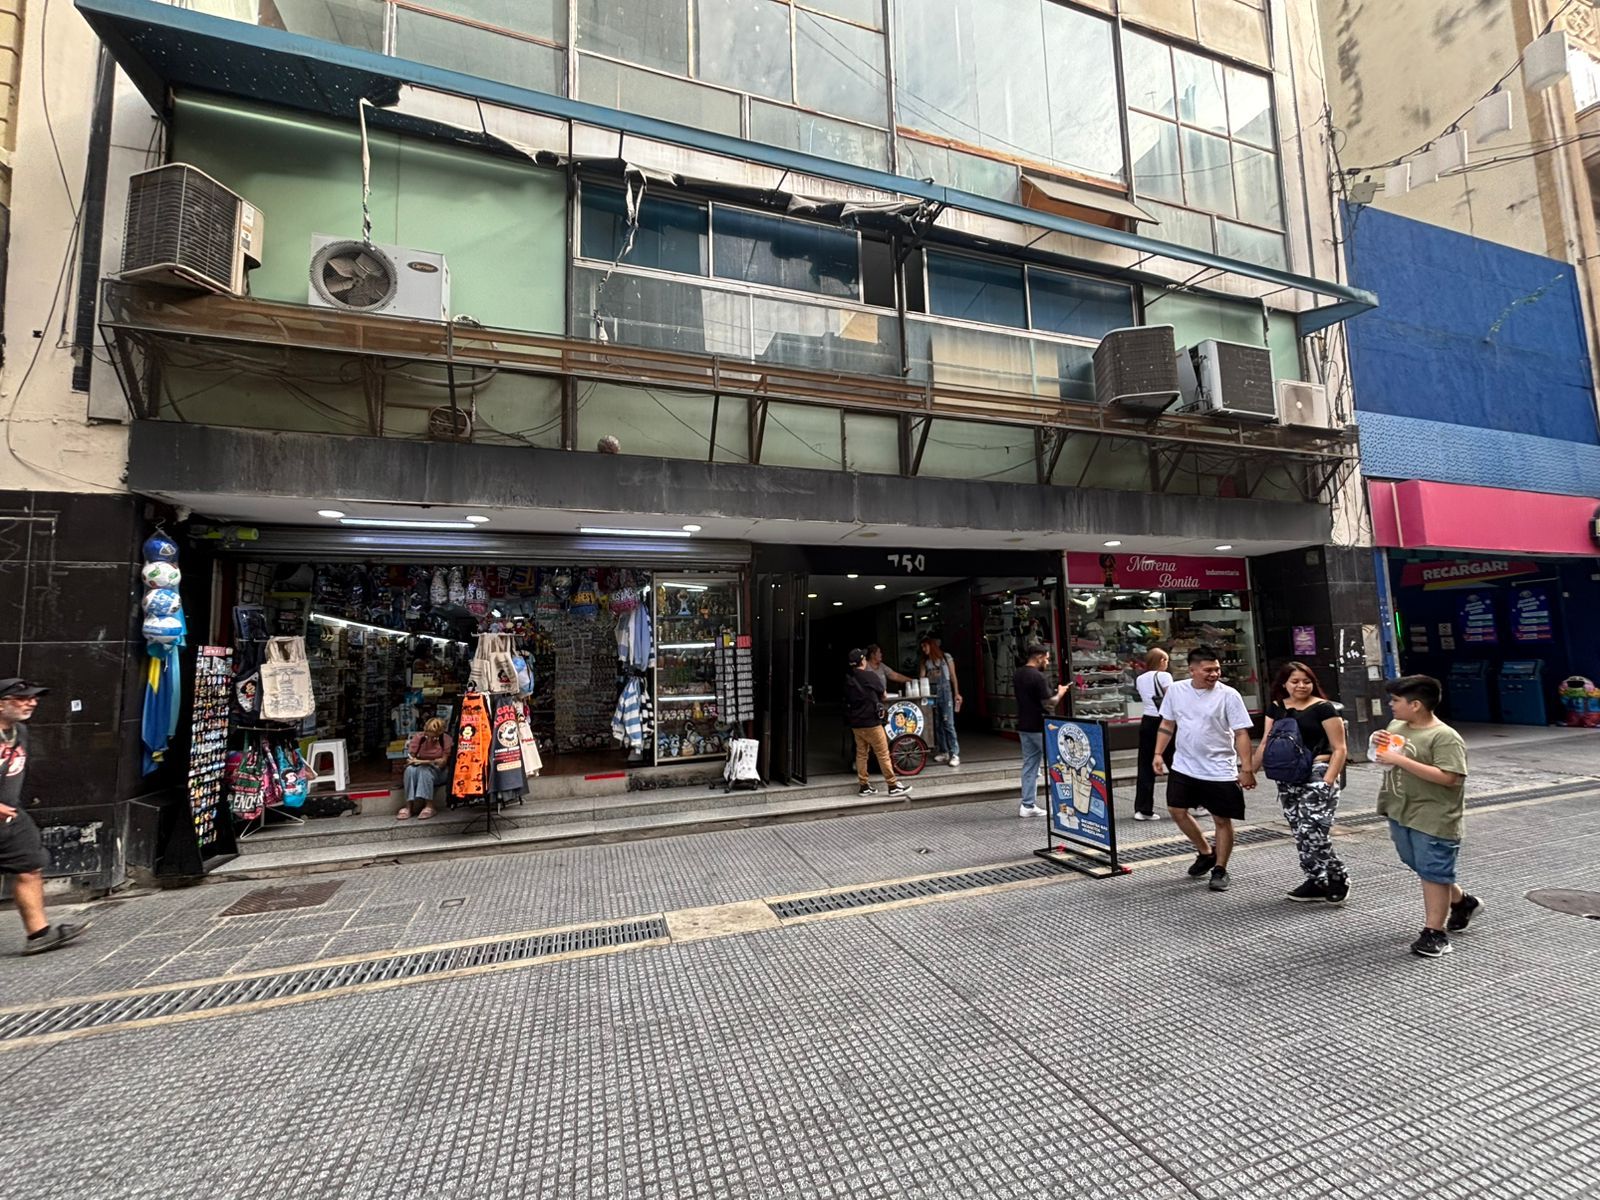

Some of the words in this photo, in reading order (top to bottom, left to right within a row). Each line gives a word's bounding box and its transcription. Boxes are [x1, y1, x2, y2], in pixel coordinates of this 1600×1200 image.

[888, 554, 925, 573] 750
[1126, 555, 1177, 572] Morena
[1422, 561, 1508, 580] RECARGAR!
[1158, 573, 1200, 588] Bonita
